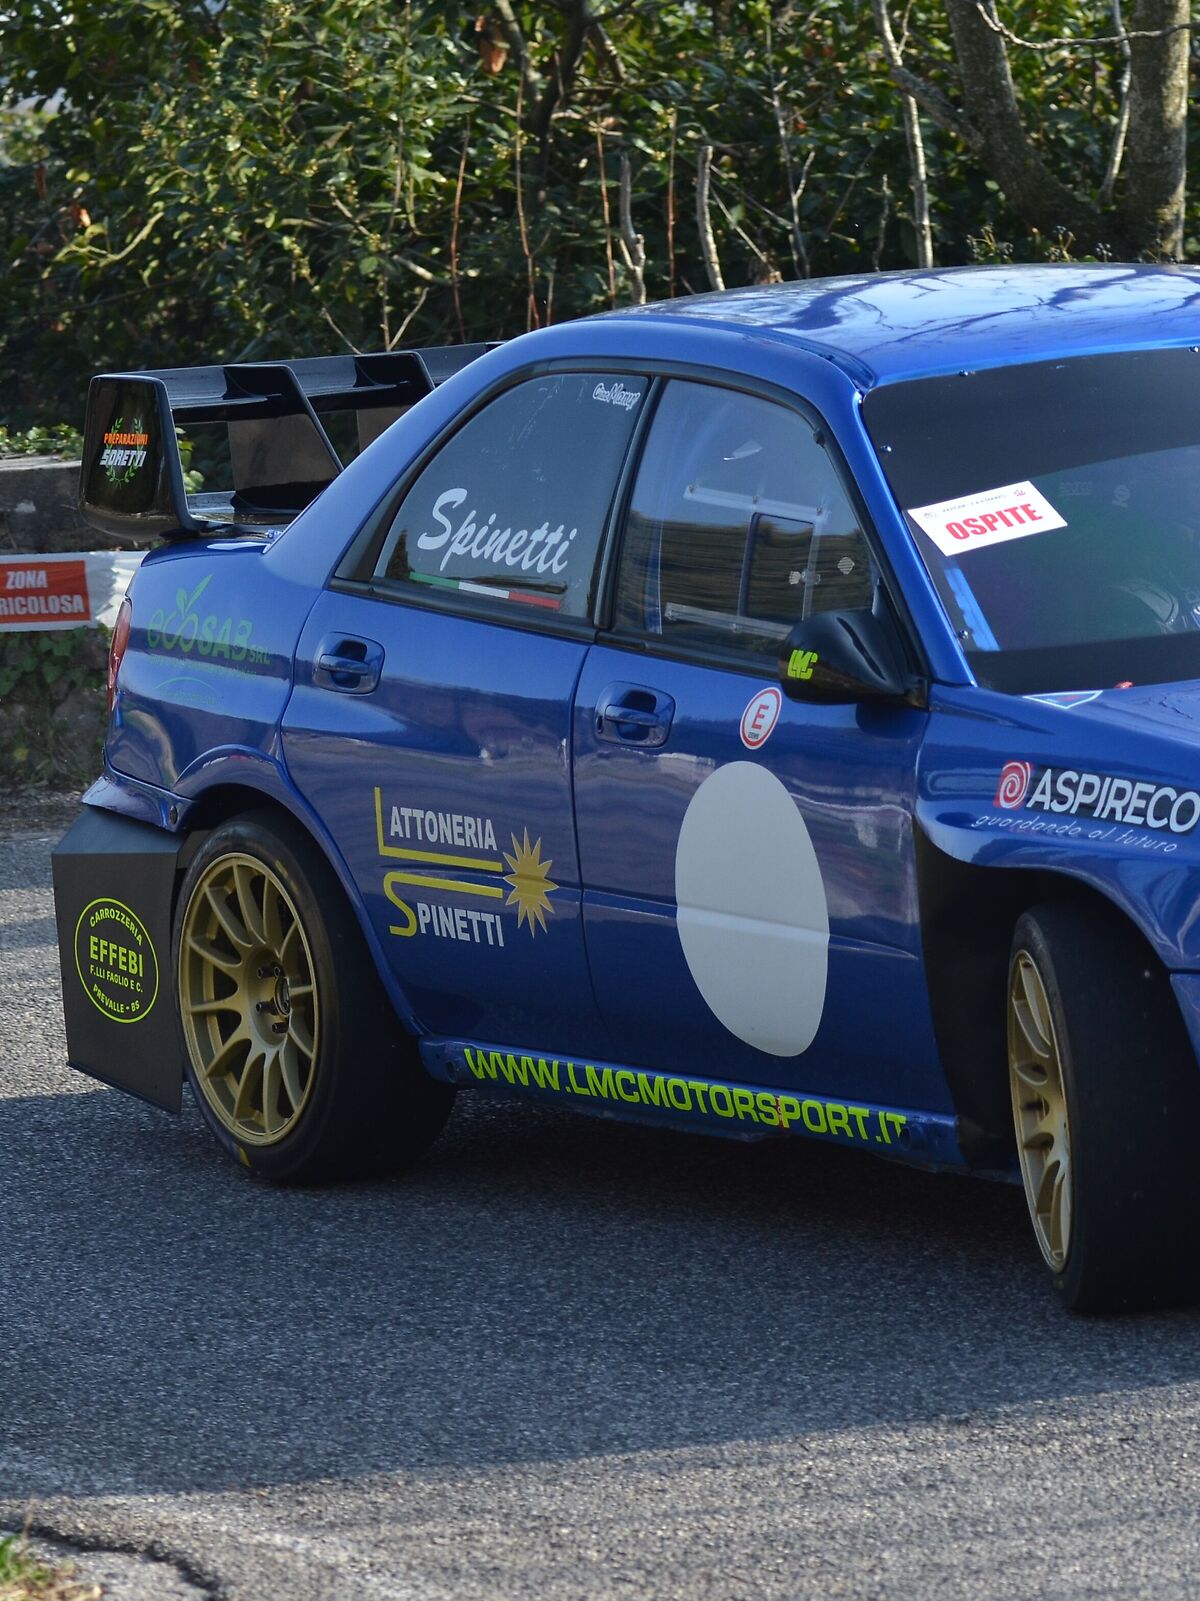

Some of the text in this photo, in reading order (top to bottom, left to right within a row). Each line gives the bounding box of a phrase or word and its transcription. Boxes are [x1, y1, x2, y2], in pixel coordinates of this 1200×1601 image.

[103, 432, 149, 446] PREPARAZIONI
[99, 448, 147, 468] SORETTI
[417, 487, 578, 575] Spinetti
[945, 503, 1043, 540] OSPITE
[5, 570, 48, 590] ZONA
[0, 594, 85, 616] RICOLOSA
[751, 704, 770, 730] E
[970, 814, 1178, 853] guardando al futuro
[90, 907, 143, 946] CARROZZERIA
[90, 935, 143, 978] EFFEBI
[106, 970, 129, 989] FAGLIO
[130, 980, 135, 990] E
[93, 983, 125, 1013] PREVALLE
[131, 1000, 140, 1012] BS
[463, 1048, 907, 1145] WWW.LMCMOTORSPORT.IT
